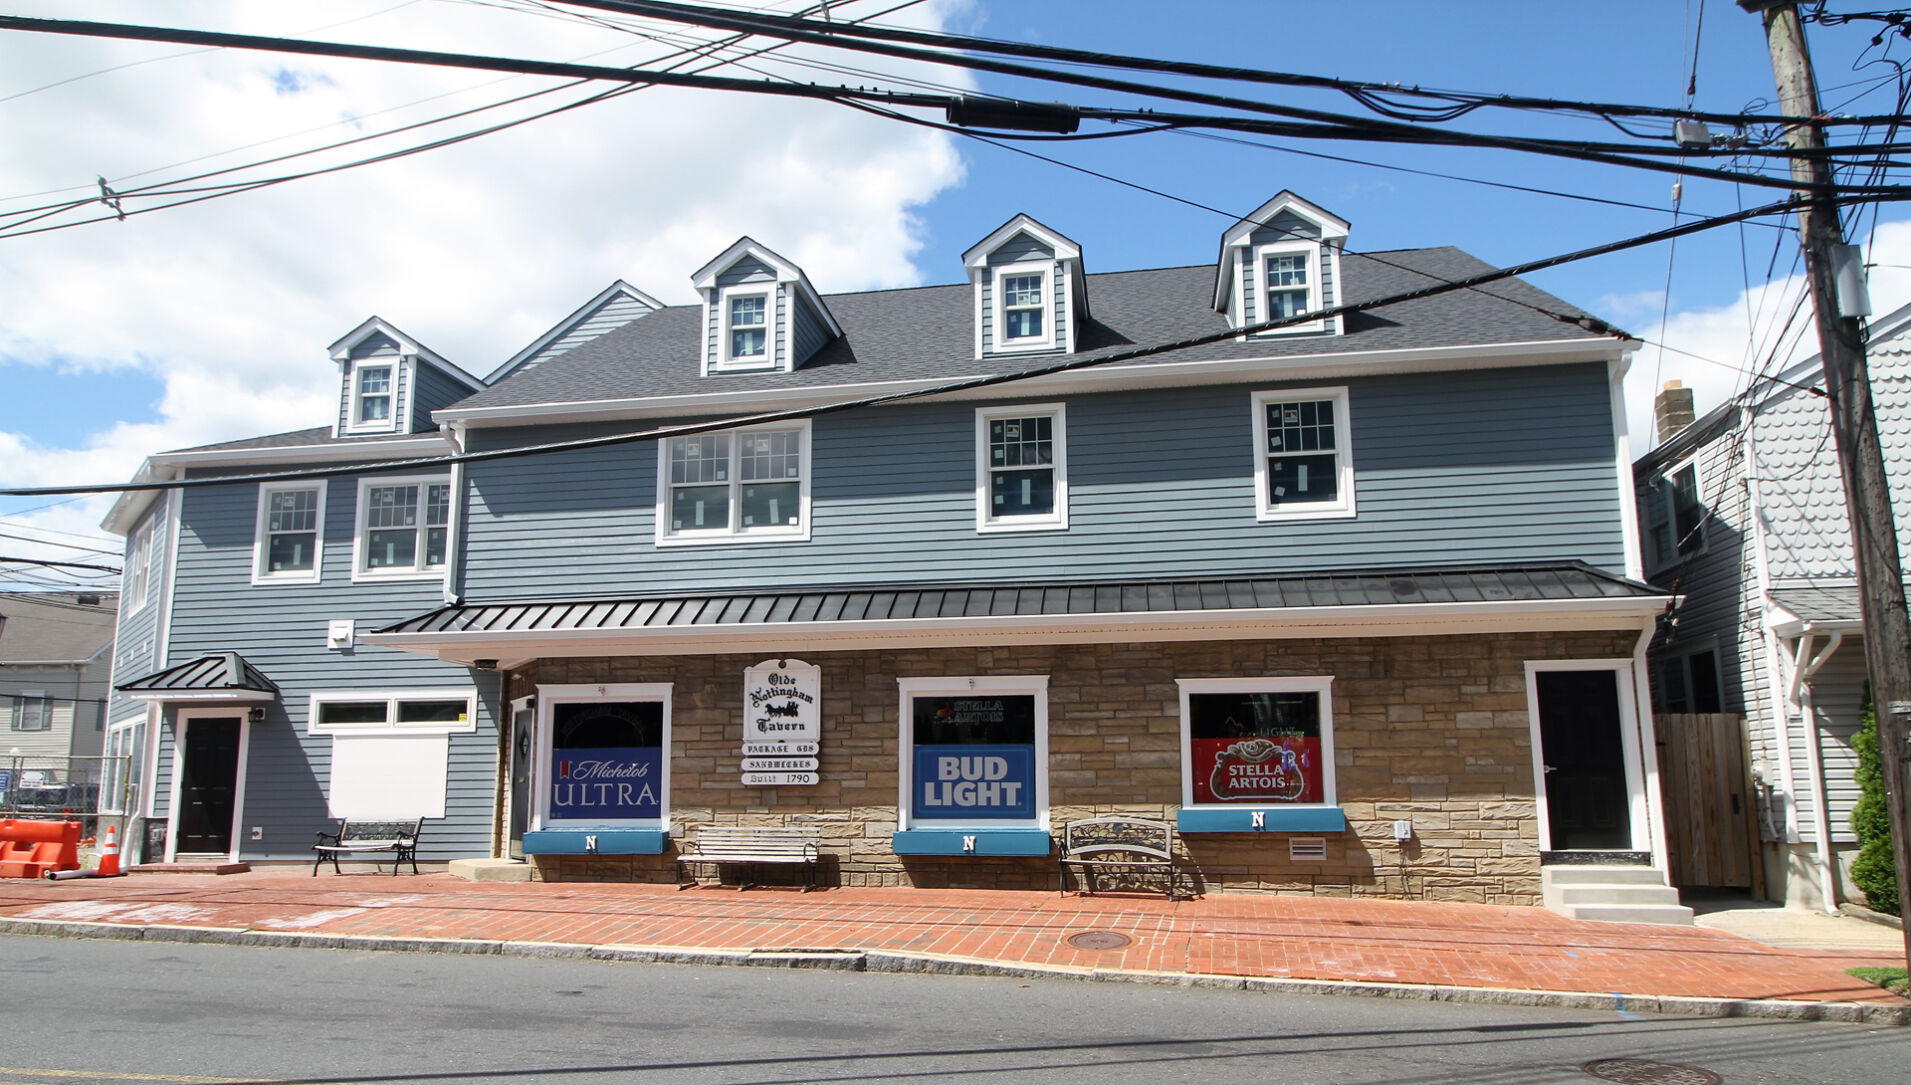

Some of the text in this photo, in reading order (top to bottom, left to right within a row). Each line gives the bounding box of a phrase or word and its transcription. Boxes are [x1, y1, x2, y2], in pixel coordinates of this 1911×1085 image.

[768, 673, 796, 686] Olde
[749, 687, 814, 708] Nottingham
[756, 718, 806, 734] Tavern
[748, 745, 789, 753] PACKAGE
[573, 760, 650, 780] Michelob
[749, 760, 811, 769] SANDWICHES
[938, 756, 1008, 781] BUD
[1229, 765, 1285, 776] STELLA
[750, 774, 810, 784] Built 1790
[1229, 777, 1286, 788] ARTOIS
[553, 782, 658, 807] ULTRA
[925, 781, 1022, 807] LIGHT
[1251, 811, 1265, 827] N
[585, 835, 597, 850] N
[962, 835, 976, 851] N
